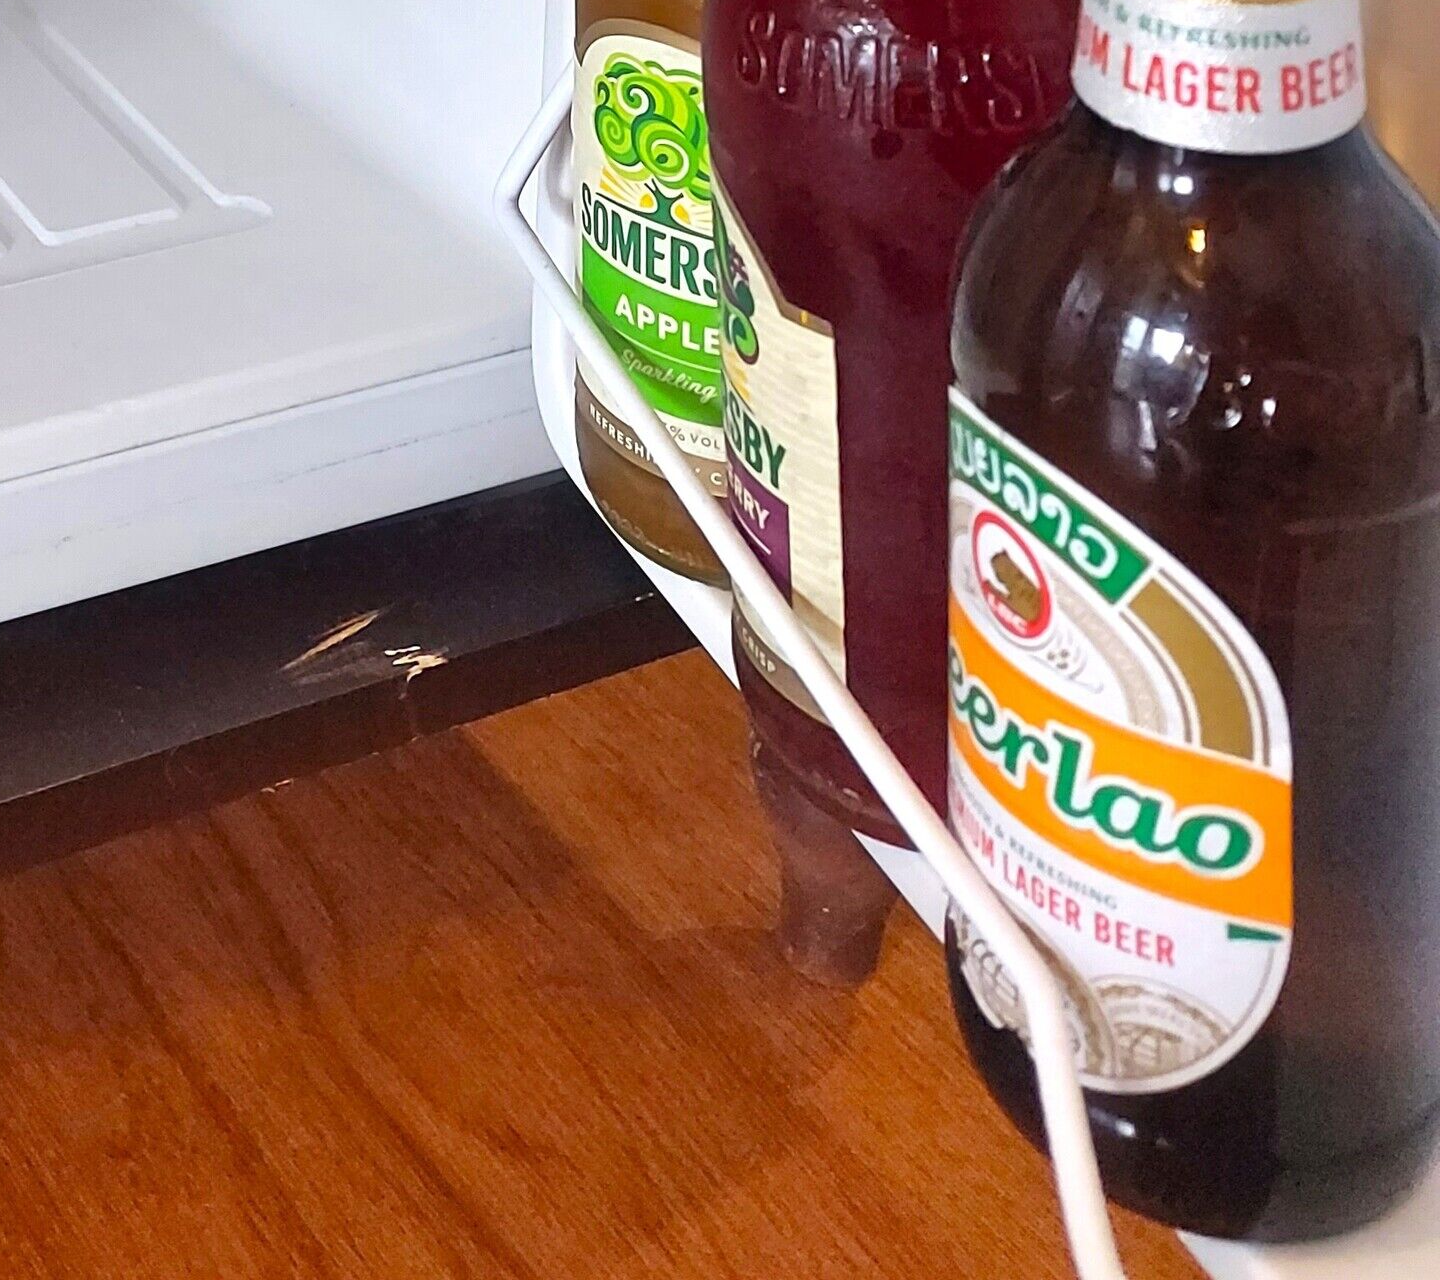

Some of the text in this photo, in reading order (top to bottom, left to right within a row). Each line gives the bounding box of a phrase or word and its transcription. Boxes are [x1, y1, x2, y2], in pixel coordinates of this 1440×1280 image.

[1122, 43, 1261, 113] LAGER
[1280, 41, 1358, 113] BEER
[614, 293, 720, 357] APPLE
[620, 348, 718, 405] Sparkling
[690, 433, 721, 450] VOL
[1002, 851, 1176, 968] LAGER BEER
